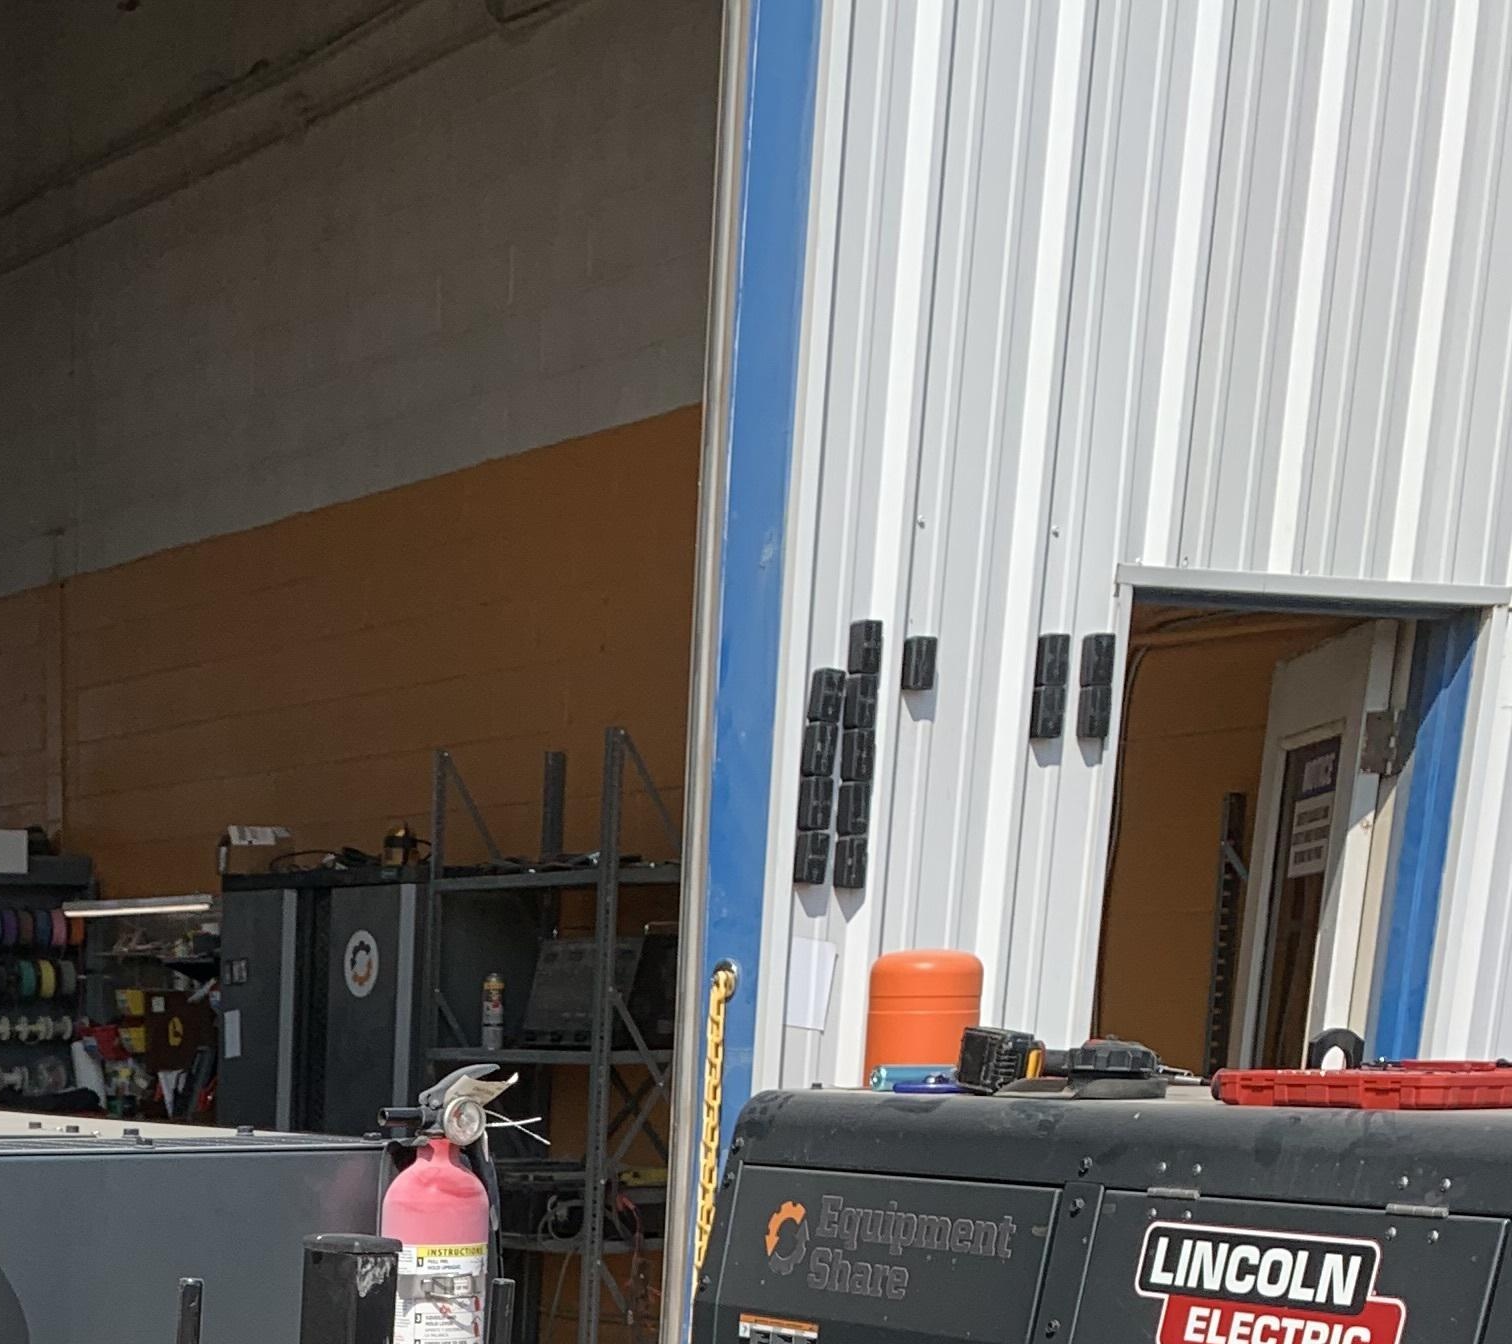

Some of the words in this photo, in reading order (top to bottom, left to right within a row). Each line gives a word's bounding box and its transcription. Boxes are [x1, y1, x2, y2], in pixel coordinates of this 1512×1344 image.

[815, 1194, 1017, 1259] Equipment
[806, 1246, 909, 1300] Share
[1149, 1236, 1362, 1307] LINCOLN
